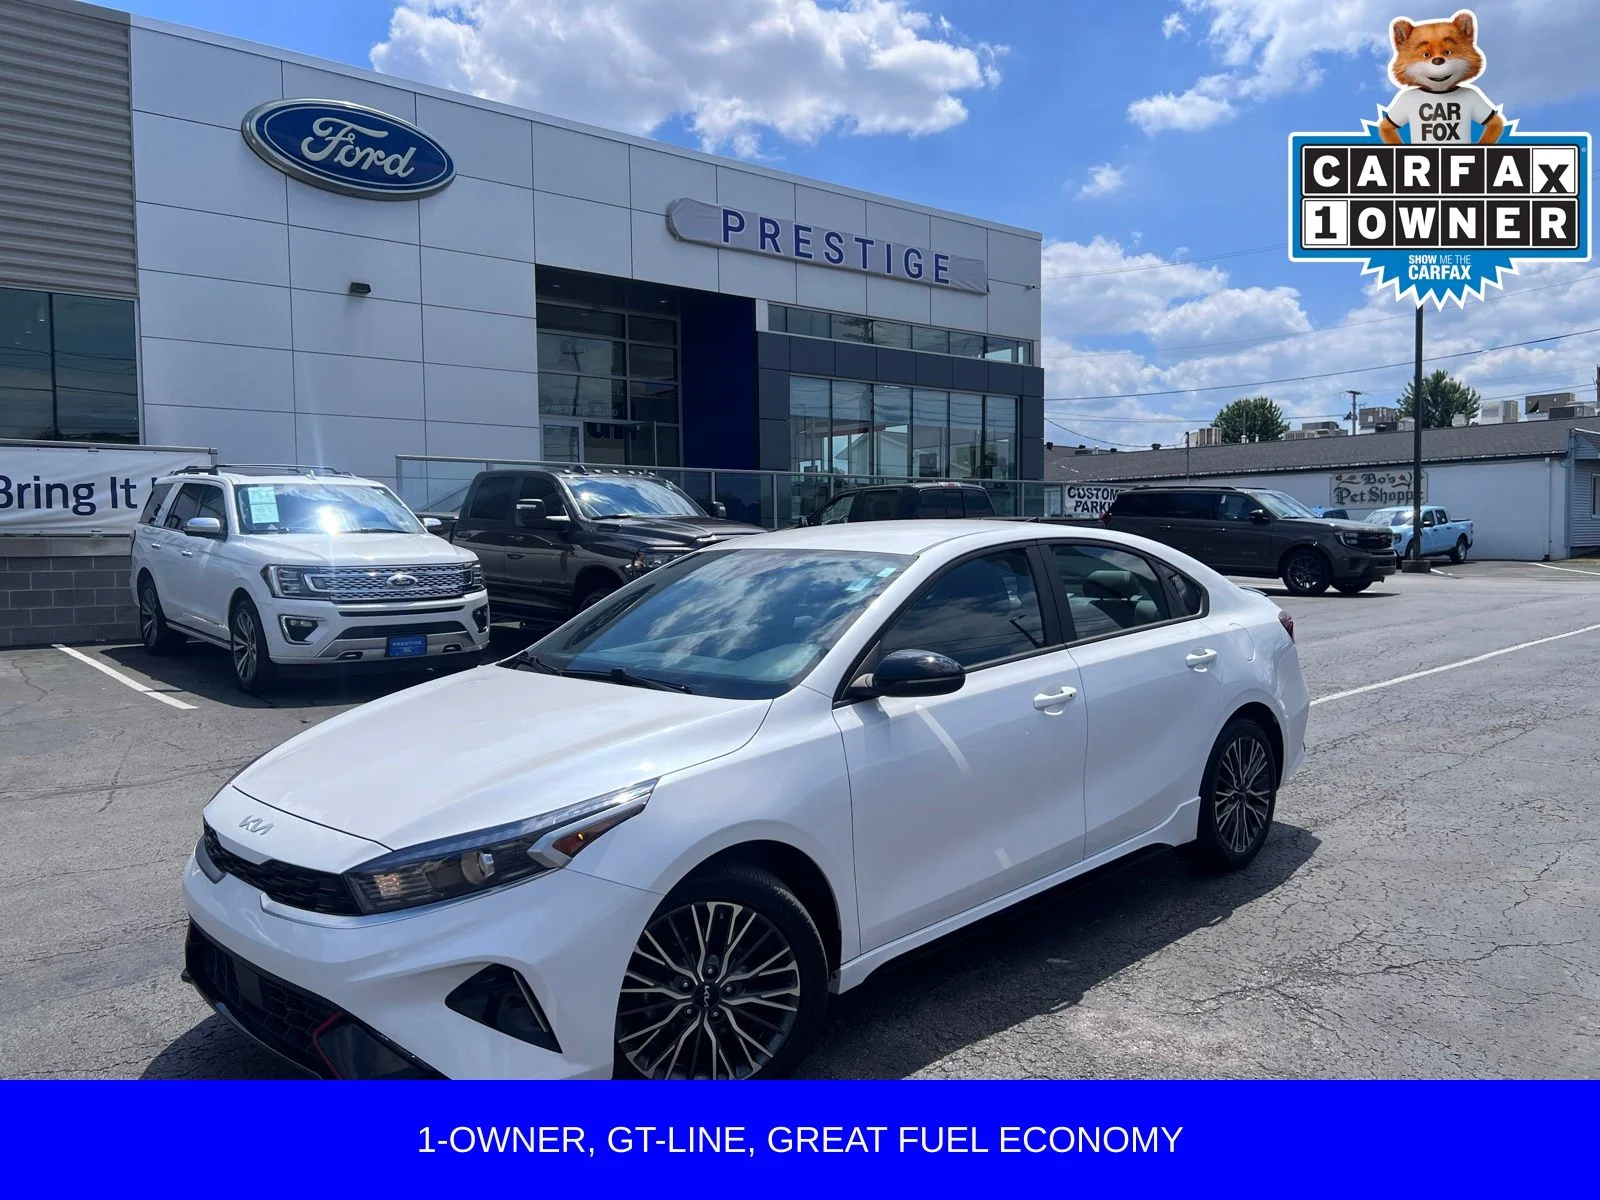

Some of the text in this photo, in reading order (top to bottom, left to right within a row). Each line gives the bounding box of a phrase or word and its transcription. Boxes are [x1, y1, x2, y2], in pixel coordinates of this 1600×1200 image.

[301, 117, 417, 178] Ford
[721, 207, 951, 285] PRESTIGE
[110, 476, 138, 509] It
[1361, 472, 1397, 485] Bo's
[1333, 486, 1366, 505] Pet
